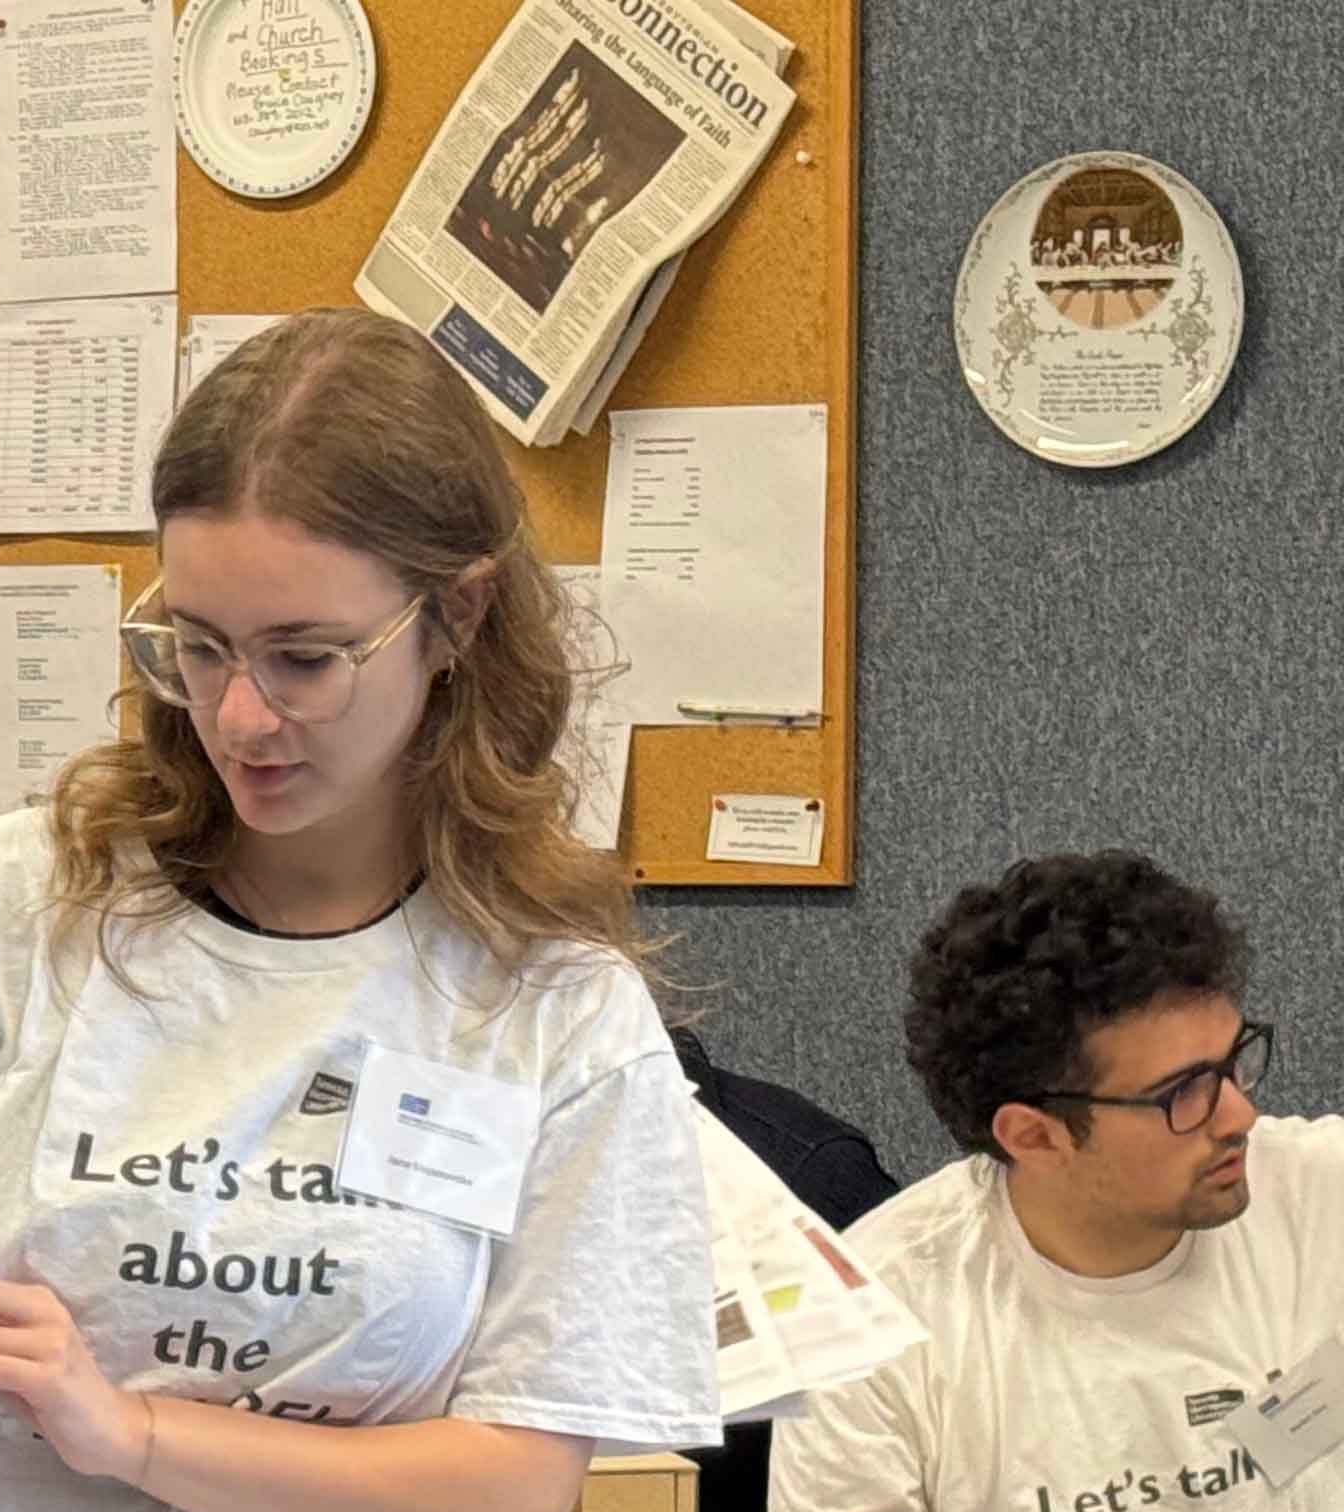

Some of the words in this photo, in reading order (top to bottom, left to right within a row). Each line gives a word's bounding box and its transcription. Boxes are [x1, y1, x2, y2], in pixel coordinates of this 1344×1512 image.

[256, 17, 324, 49] Church
[607, 0, 769, 128] onnection
[604, 33, 628, 59] the
[626, 50, 688, 108] Language
[683, 98, 703, 119] of
[697, 112, 734, 149] Faith
[70, 1132, 241, 1201] Let's
[118, 1231, 339, 1297] about
[153, 1320, 271, 1374] the
